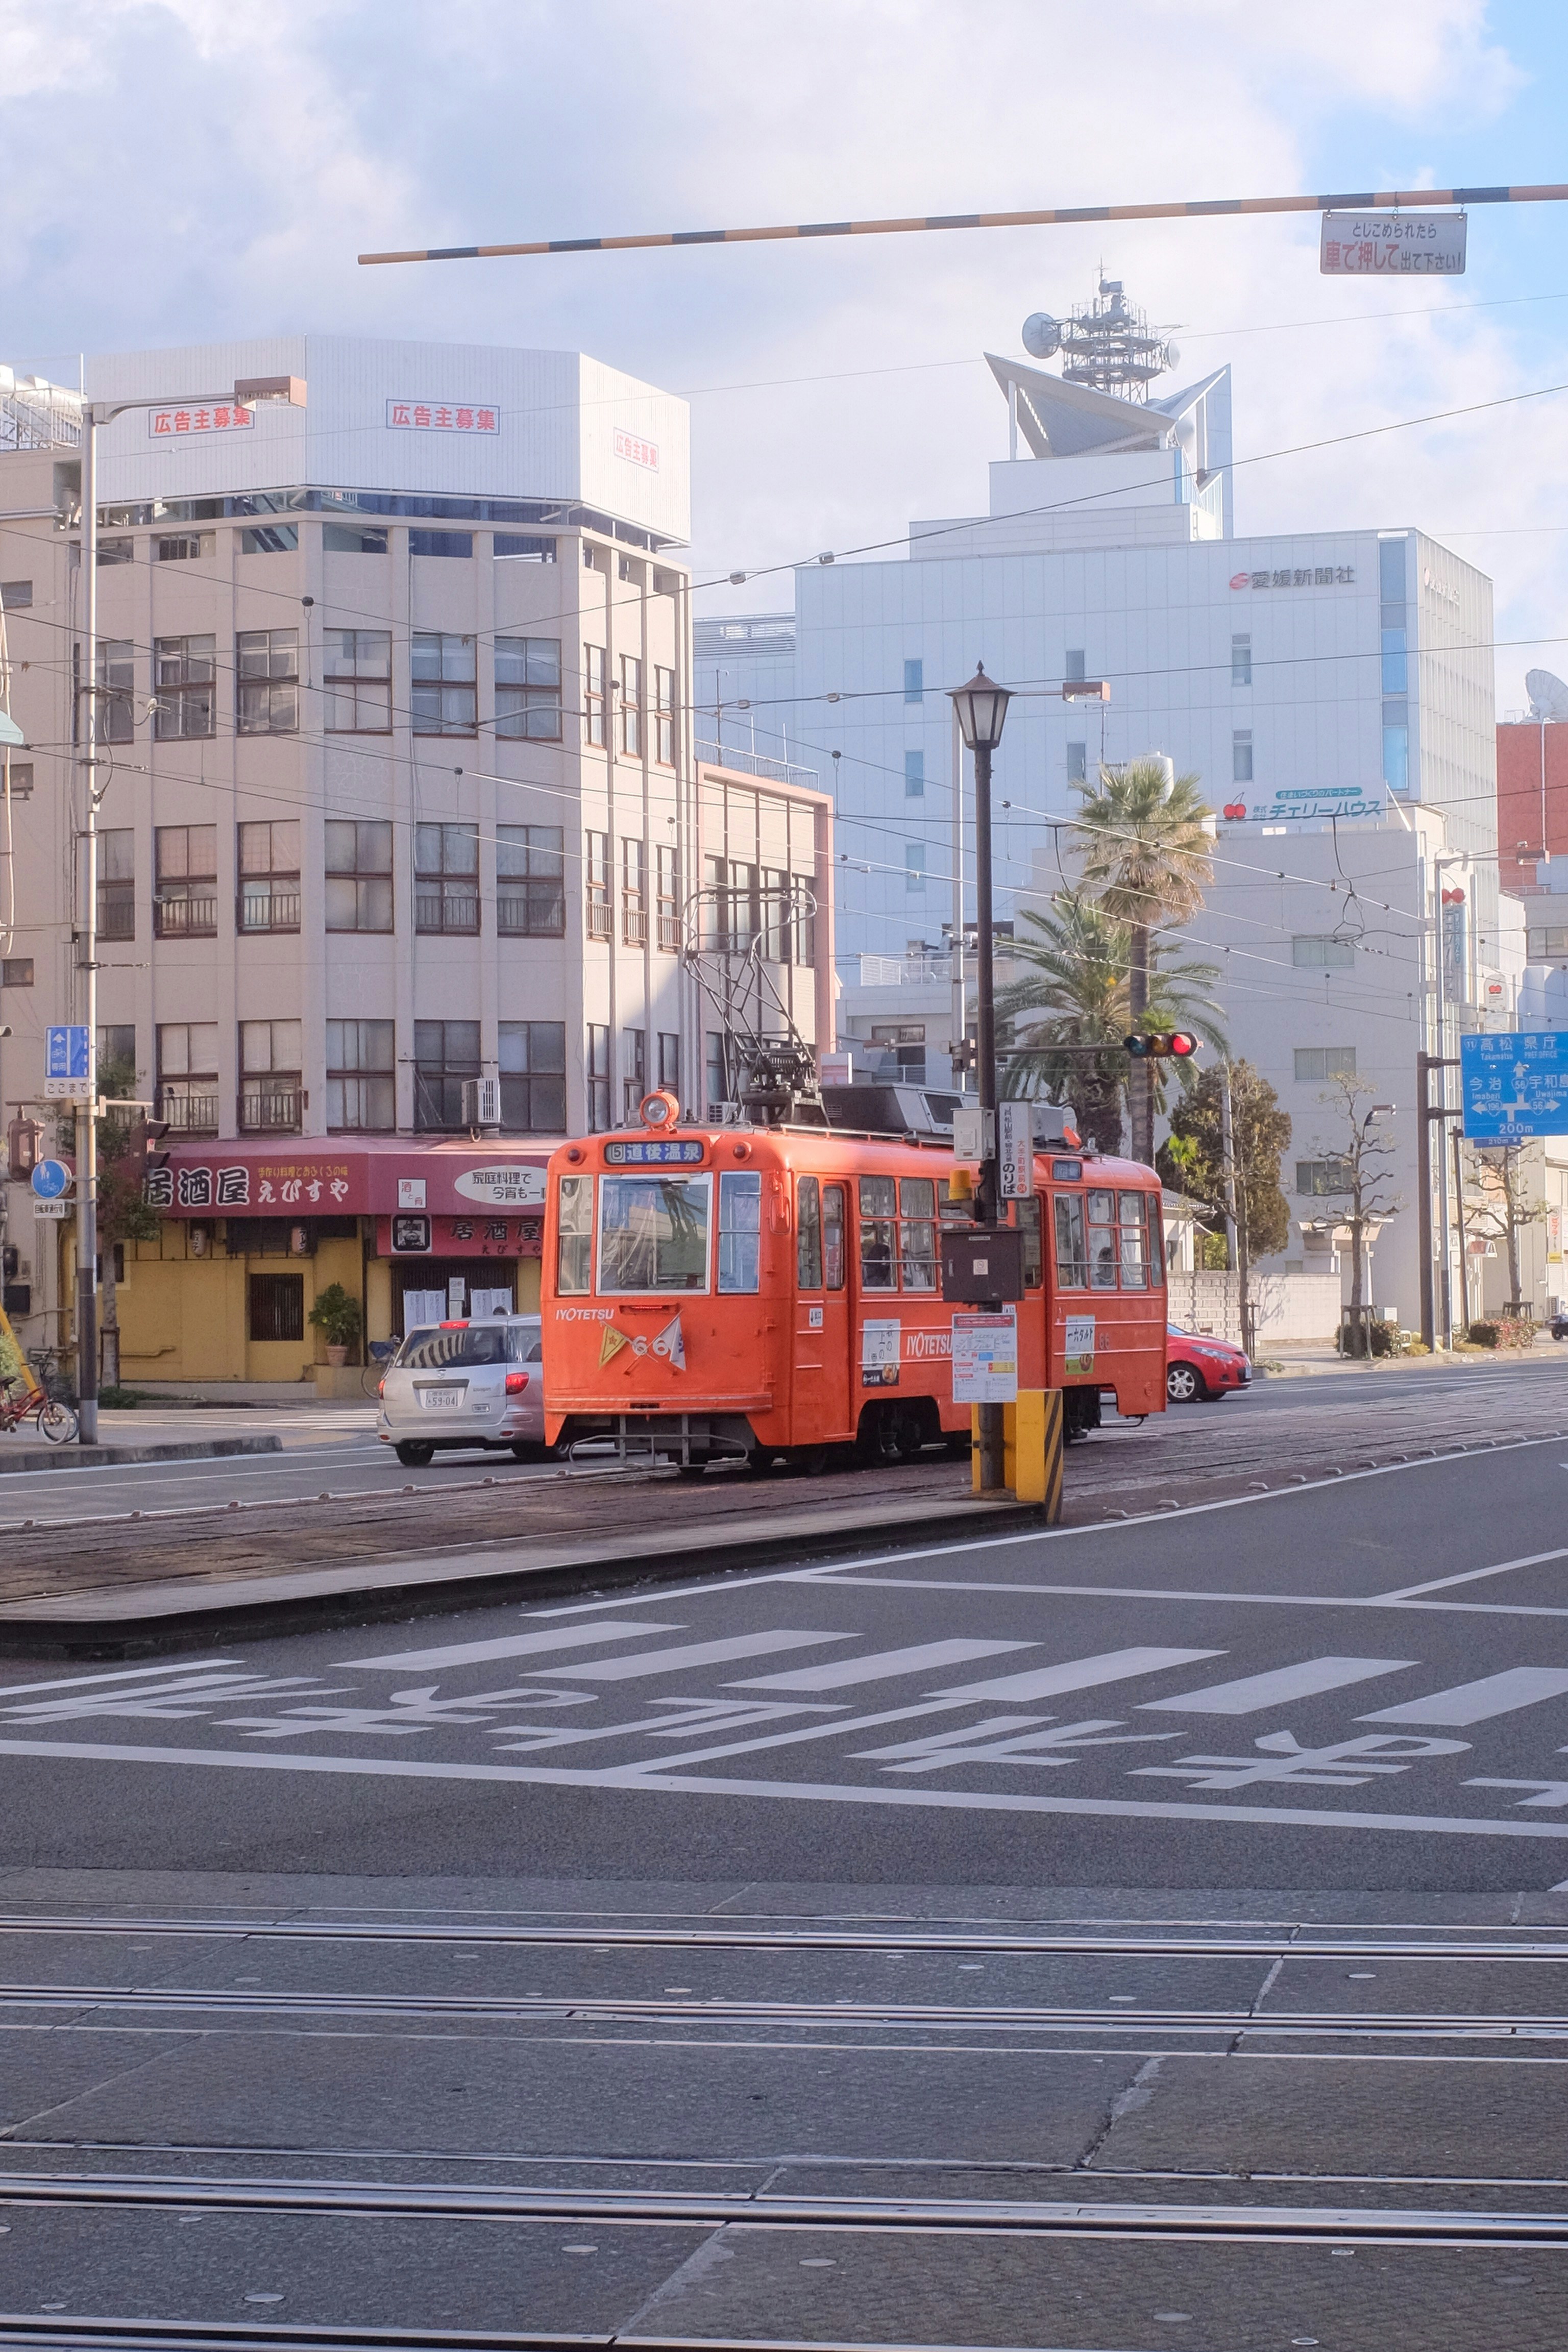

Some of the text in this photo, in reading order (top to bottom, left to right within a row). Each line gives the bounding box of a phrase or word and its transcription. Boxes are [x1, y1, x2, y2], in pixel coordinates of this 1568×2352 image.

[1352, 223, 1436, 238] とじこめられたら
[154, 405, 251, 433] 広告主募集
[392, 405, 495, 430] 広告主募集
[1252, 566, 1355, 589] 愛媛新聞社
[1269, 801, 1381, 819] チェリーハウス
[1481, 1037, 1512, 1051] 高松
[1524, 1035, 1557, 1050] 県庁
[48, 1083, 87, 1094] ここまで
[1469, 1077, 1502, 1091] 今治
[1536, 1090, 1567, 1098] Uwajima
[1499, 1123, 1534, 1134] 200m
[627, 1143, 699, 1160] 道後温泉
[145, 1166, 250, 1207] 居酒屋
[473, 1172, 532, 1184] 家庭料理で
[258, 1178, 349, 1204] えびすや
[451, 1220, 541, 1241] 居酒屋
[482, 1244, 541, 1255] えびすや
[556, 1308, 614, 1321] IYOTETSU
[906, 1332, 952, 1358] IYOTETSU
[1099, 1333, 1110, 1350] 66
